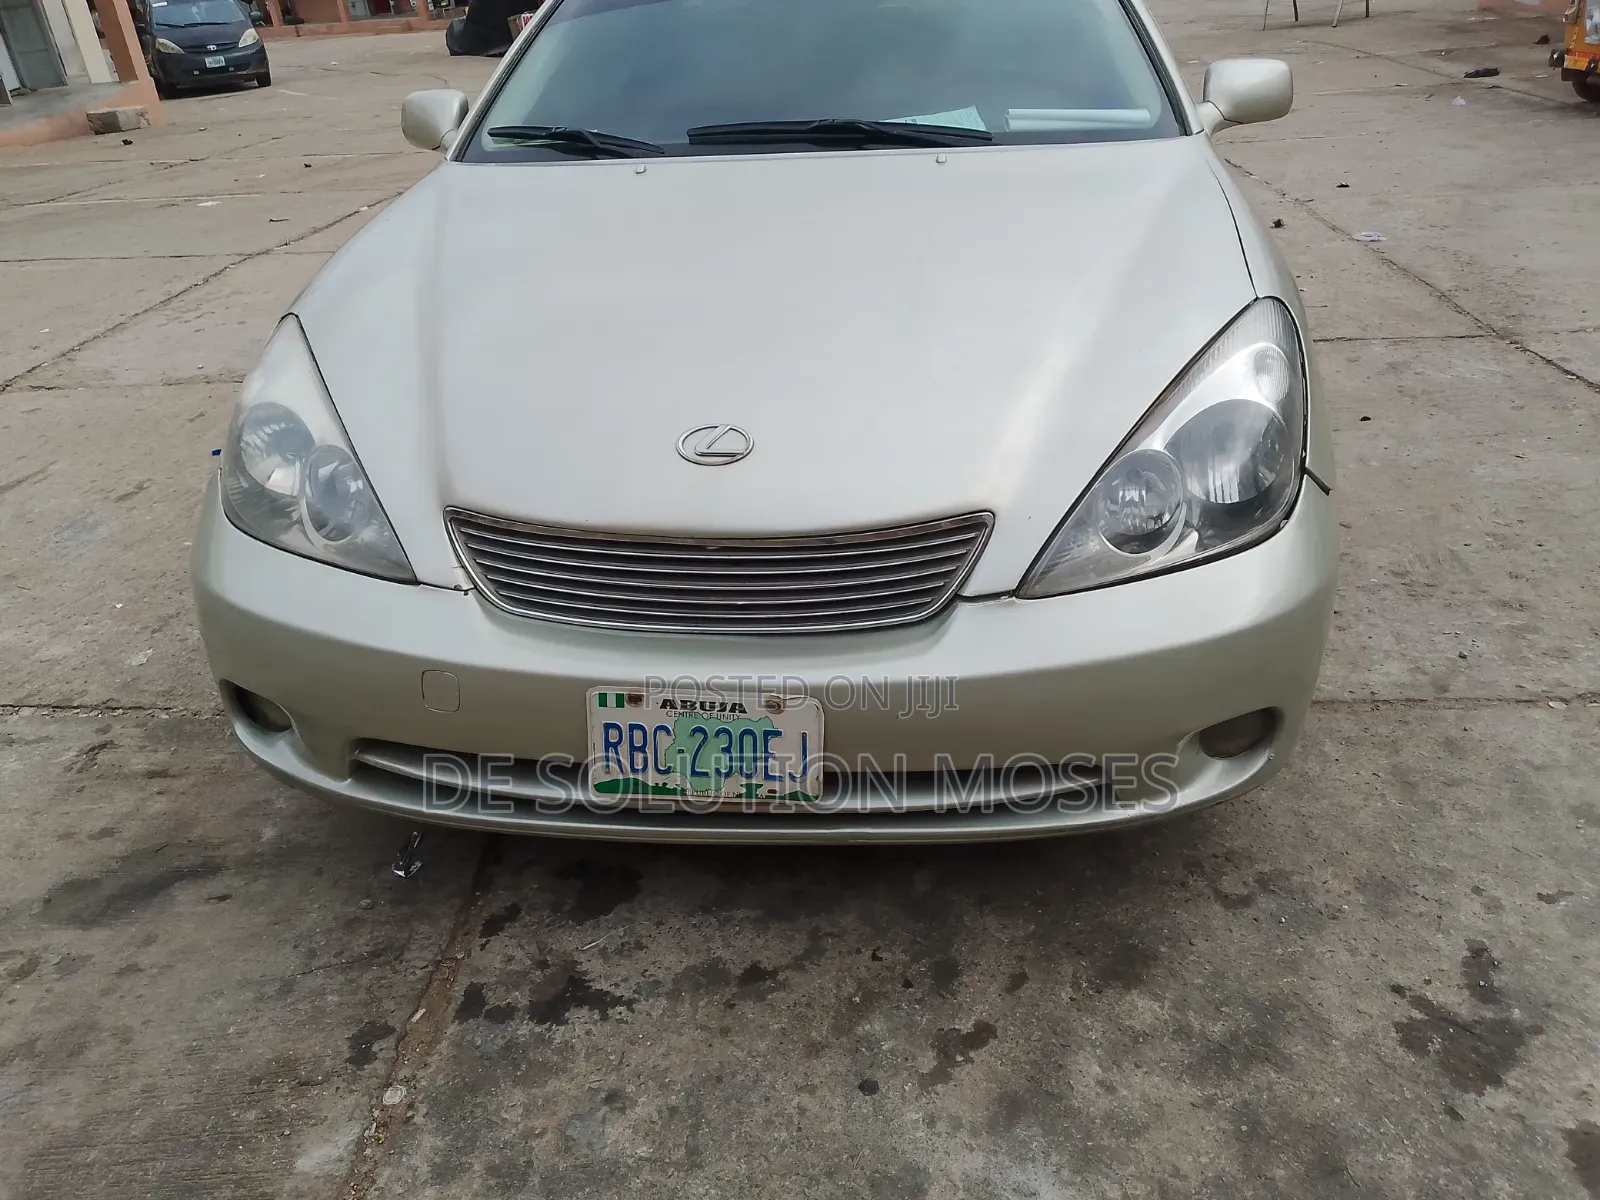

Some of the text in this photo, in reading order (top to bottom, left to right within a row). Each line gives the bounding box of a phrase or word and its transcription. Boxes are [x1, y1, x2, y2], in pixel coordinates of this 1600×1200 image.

[660, 698, 748, 714] ABUJA
[666, 710, 741, 721] CENTRE OF UNITY
